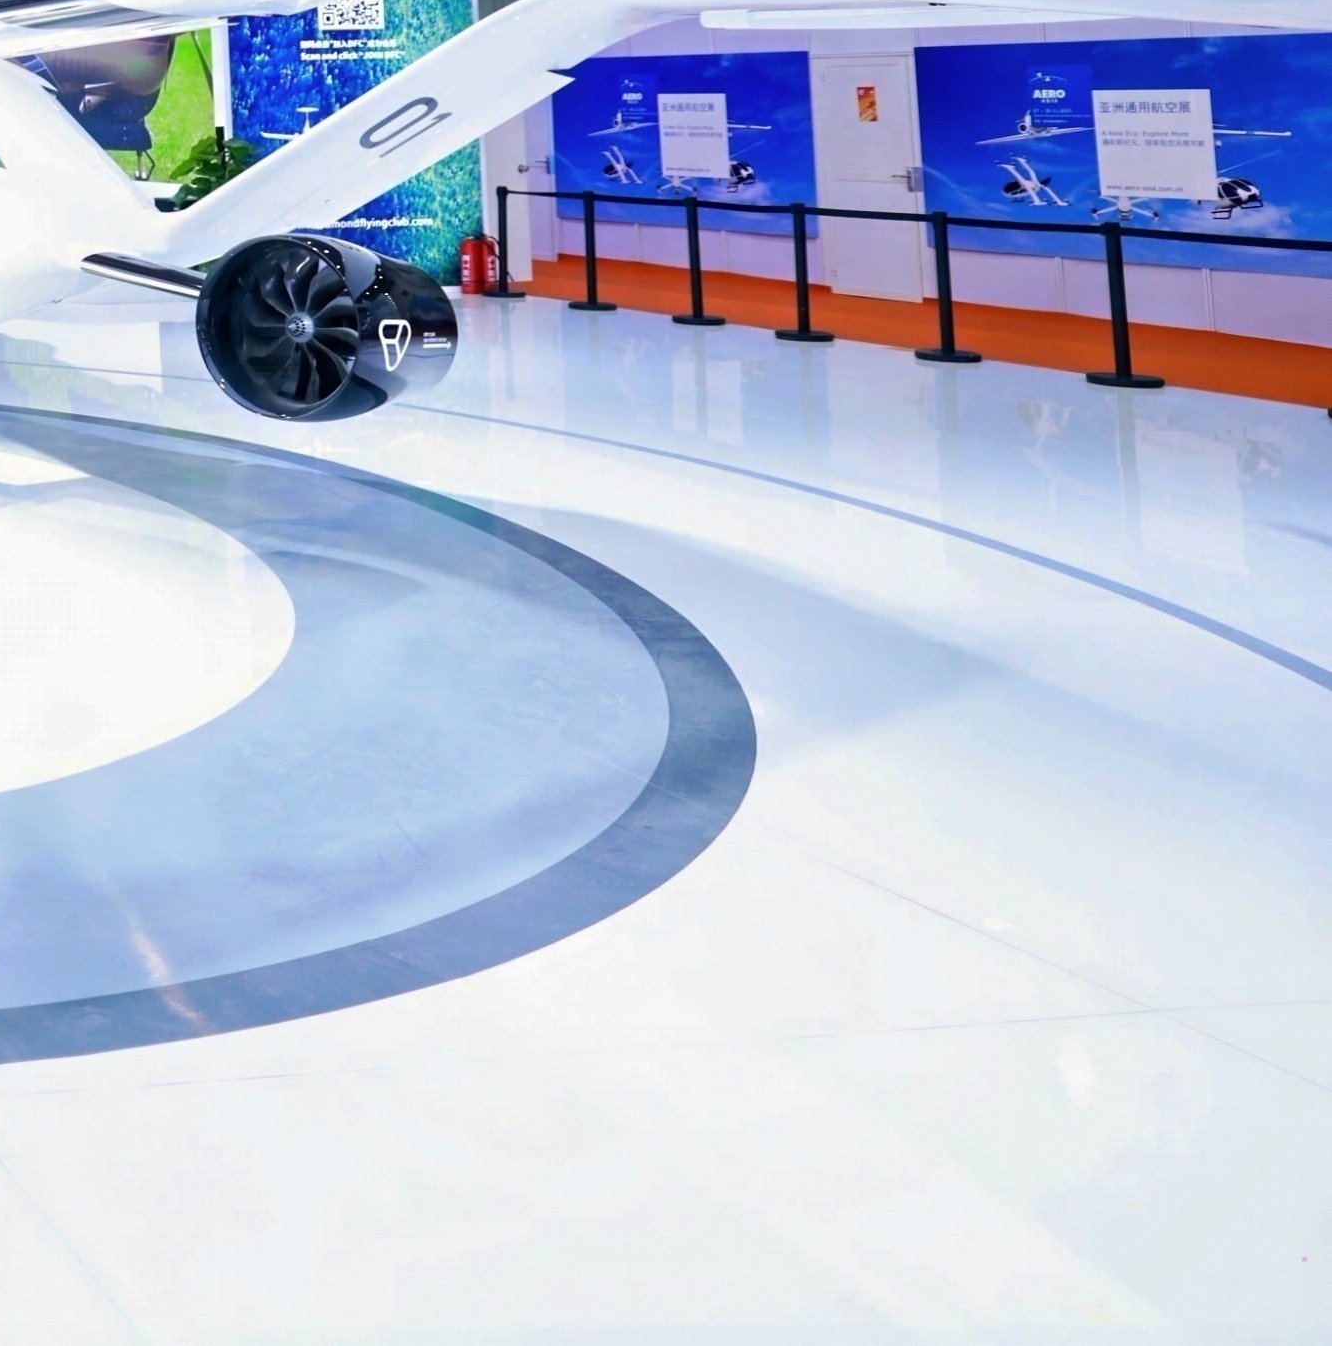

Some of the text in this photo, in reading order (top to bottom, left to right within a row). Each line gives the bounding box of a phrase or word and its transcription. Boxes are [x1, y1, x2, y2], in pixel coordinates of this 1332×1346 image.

[622, 92, 643, 101] AERO
[1033, 89, 1066, 99] AERO
[1099, 102, 1192, 114] 亚洲通用航空展
[359, 96, 453, 158] 01
[324, 217, 434, 230] mondflyingclub.com
